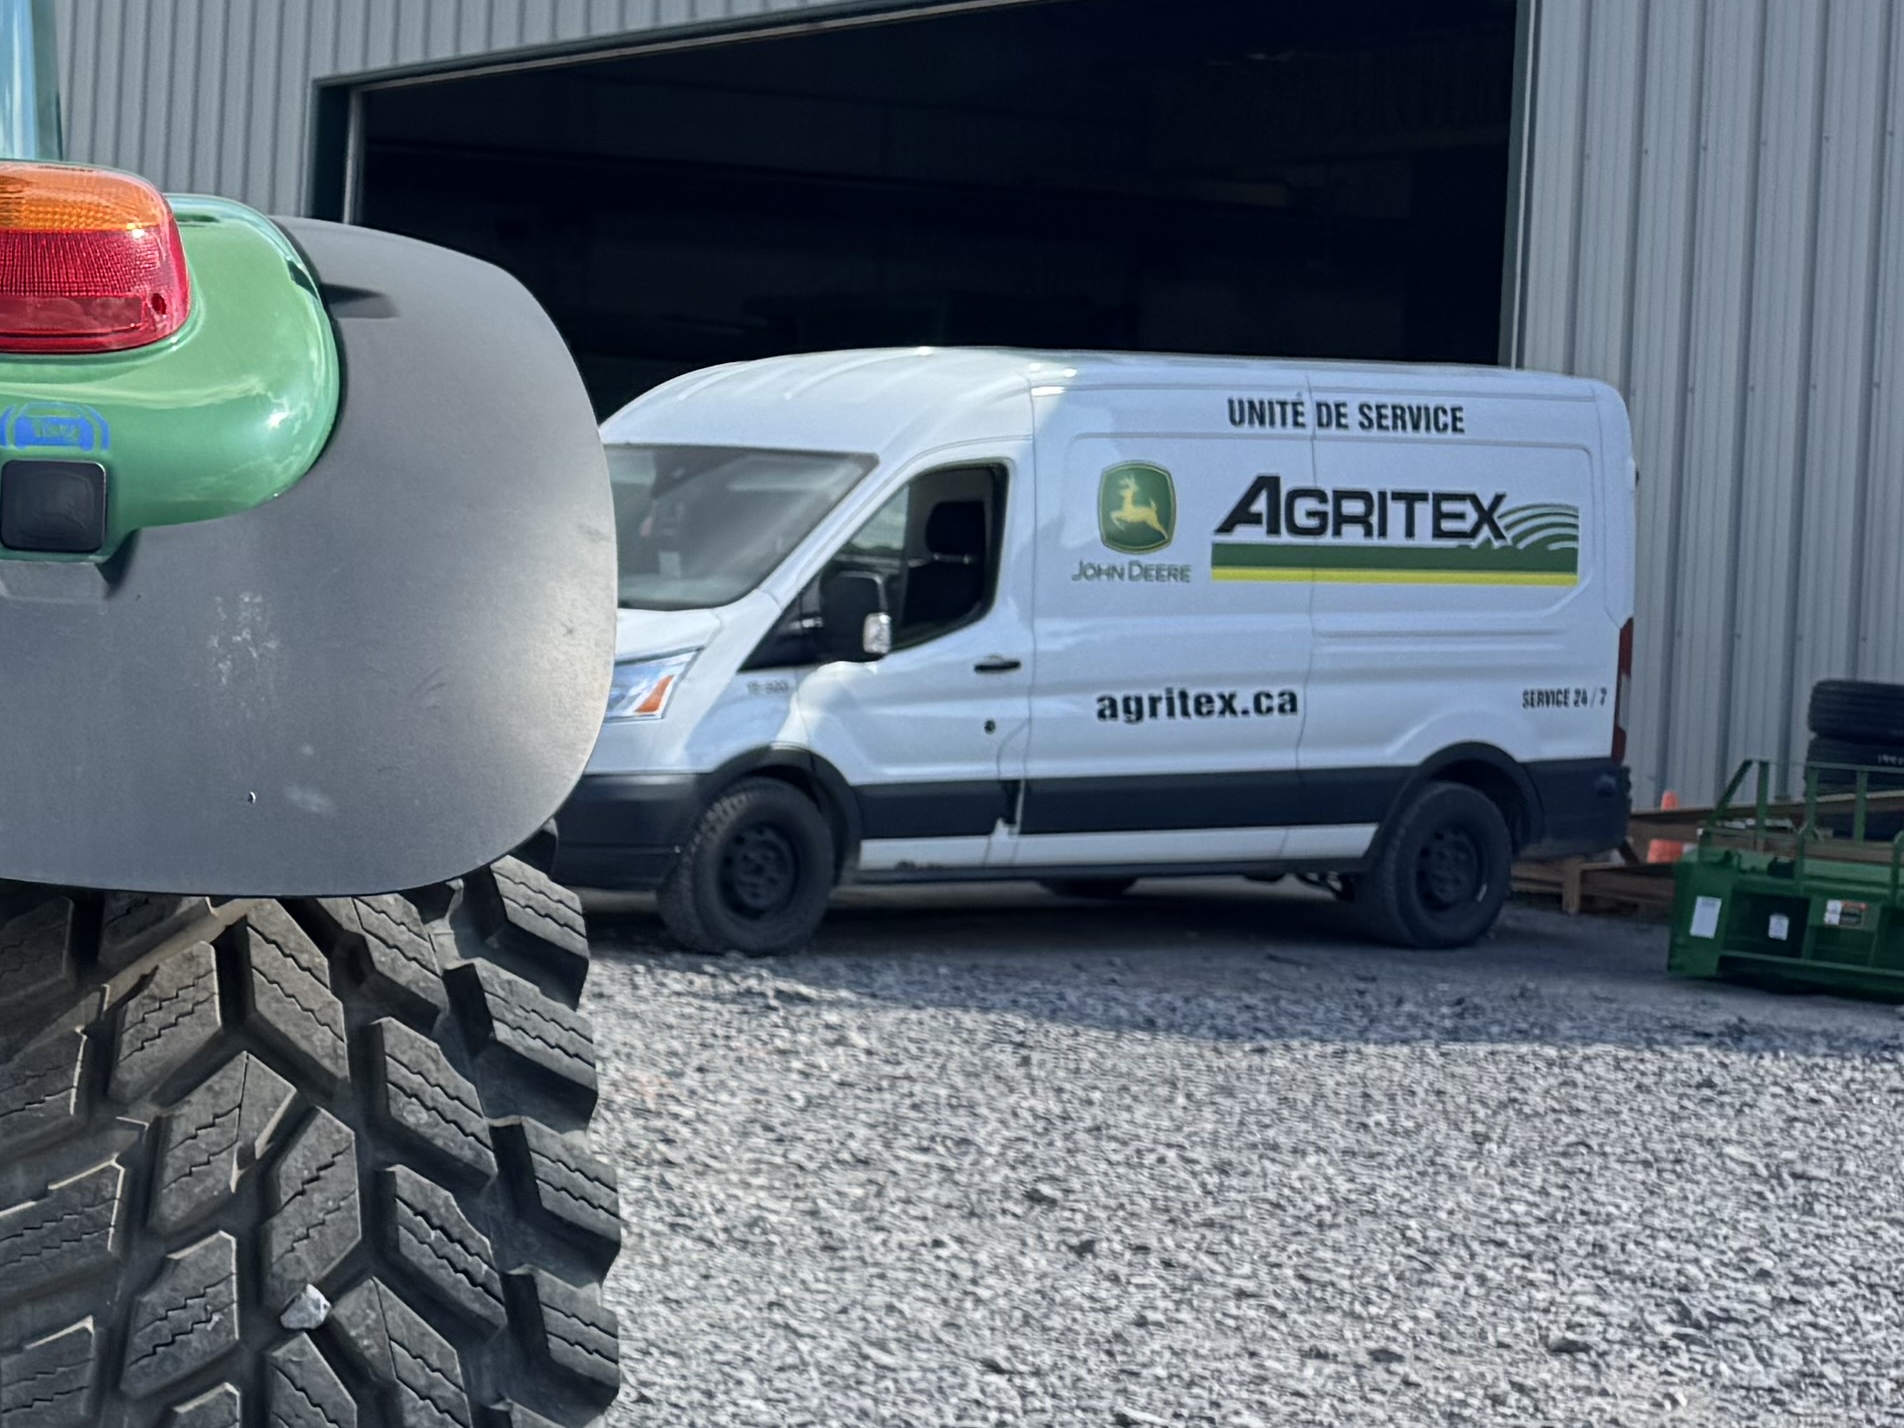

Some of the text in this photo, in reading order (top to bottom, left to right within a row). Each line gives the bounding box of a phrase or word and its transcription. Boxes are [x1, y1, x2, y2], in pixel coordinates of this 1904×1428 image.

[1228, 391, 1465, 434] UNITÉ DE SERVICE
[1214, 474, 1509, 540] AGRITEX
[1072, 559, 1191, 583] JOHN DEERE
[1096, 687, 1298, 724] agritex.ca
[1522, 688, 1569, 709] SERVICE
